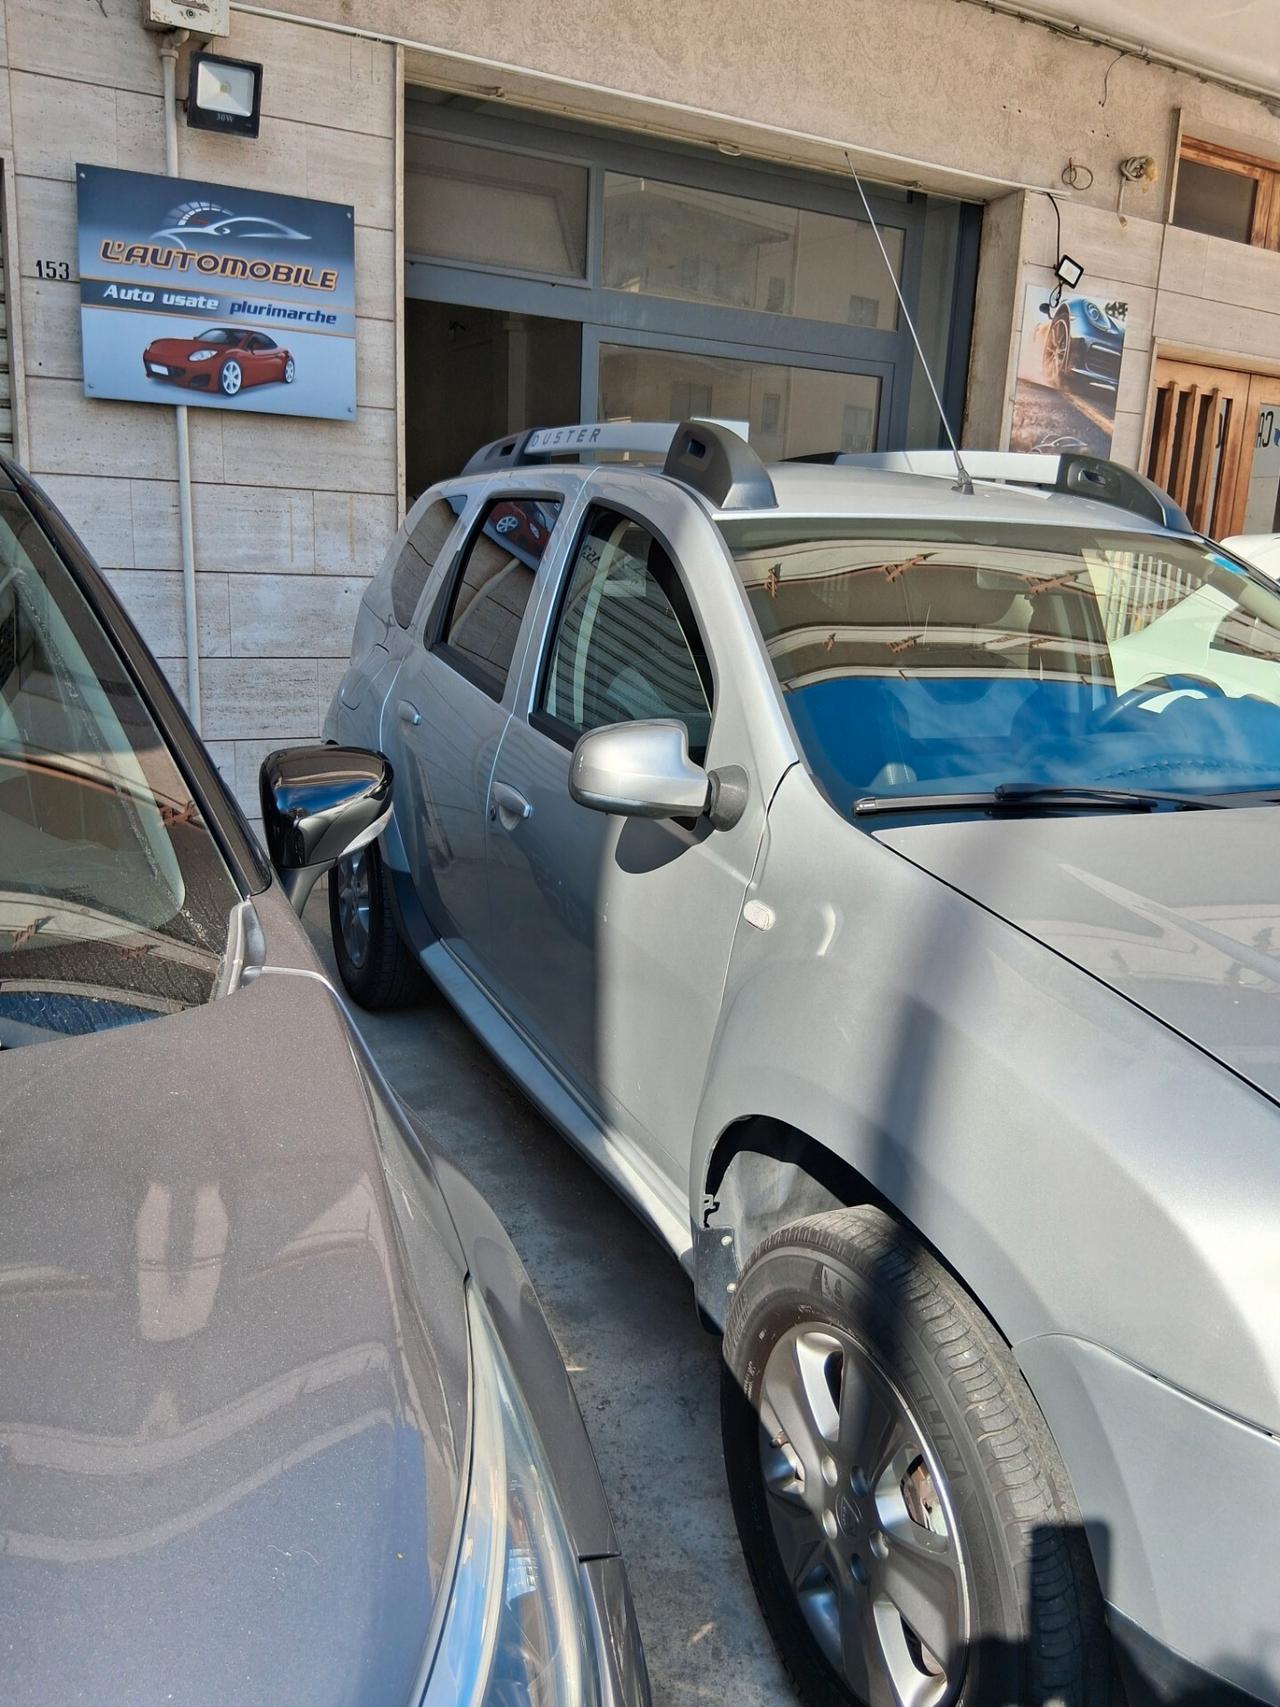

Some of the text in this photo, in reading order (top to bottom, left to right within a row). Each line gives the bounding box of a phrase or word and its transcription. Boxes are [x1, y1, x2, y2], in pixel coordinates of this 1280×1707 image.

[36, 259, 70, 280] 153
[101, 241, 338, 290] L'AUTOMOBILE
[104, 284, 337, 325] Auto usate plurimarche
[531, 428, 601, 447] DUSTER
